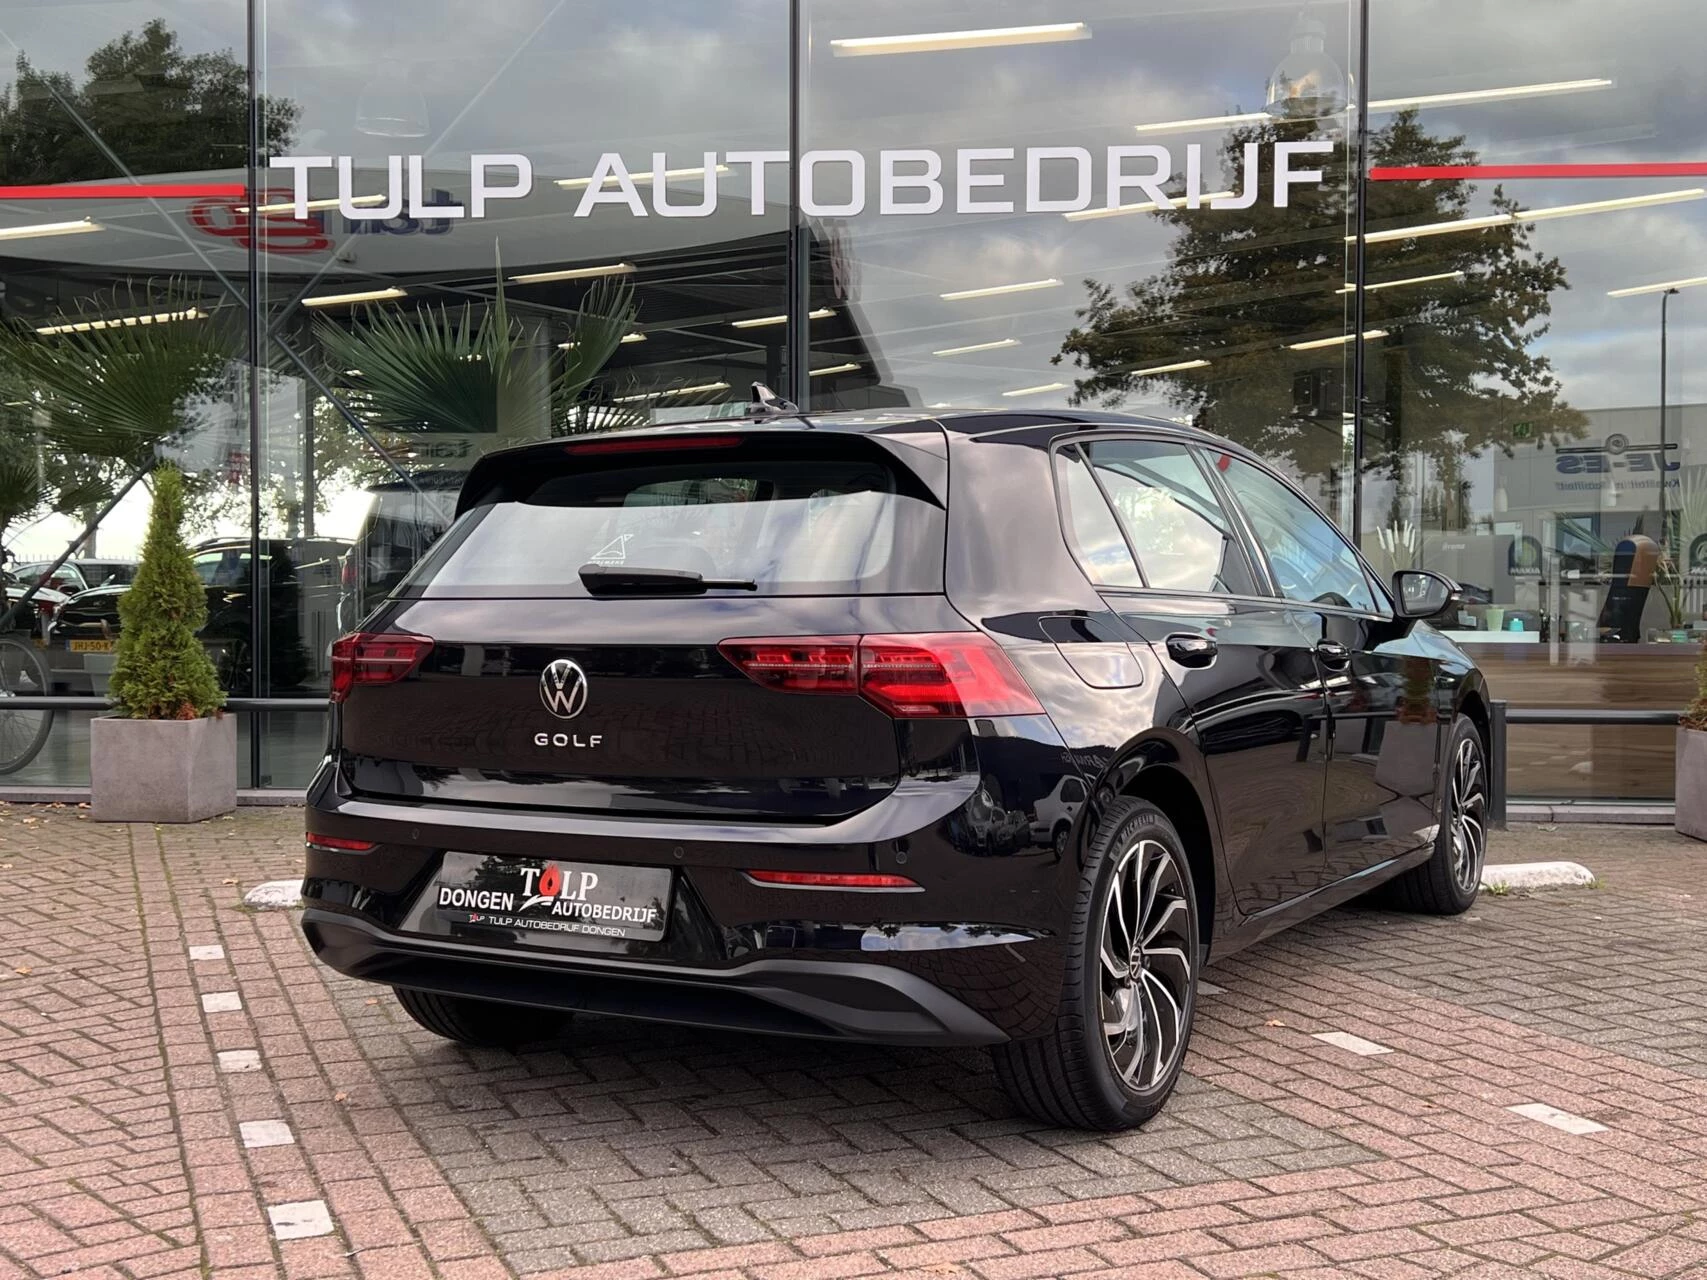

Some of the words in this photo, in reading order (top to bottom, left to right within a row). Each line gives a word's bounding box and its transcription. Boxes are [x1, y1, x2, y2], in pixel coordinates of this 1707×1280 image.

[269, 153, 532, 220] TULP
[574, 140, 1335, 218] AUTOBEDRIJF
[534, 732, 603, 748] GOLF
[439, 887, 515, 912] DONGEN
[551, 901, 658, 924] AUTOBEDRIJF
[489, 916, 513, 926] TULP
[514, 918, 580, 933] AUTOBEDRIJF
[581, 925, 626, 937] DONGEN
